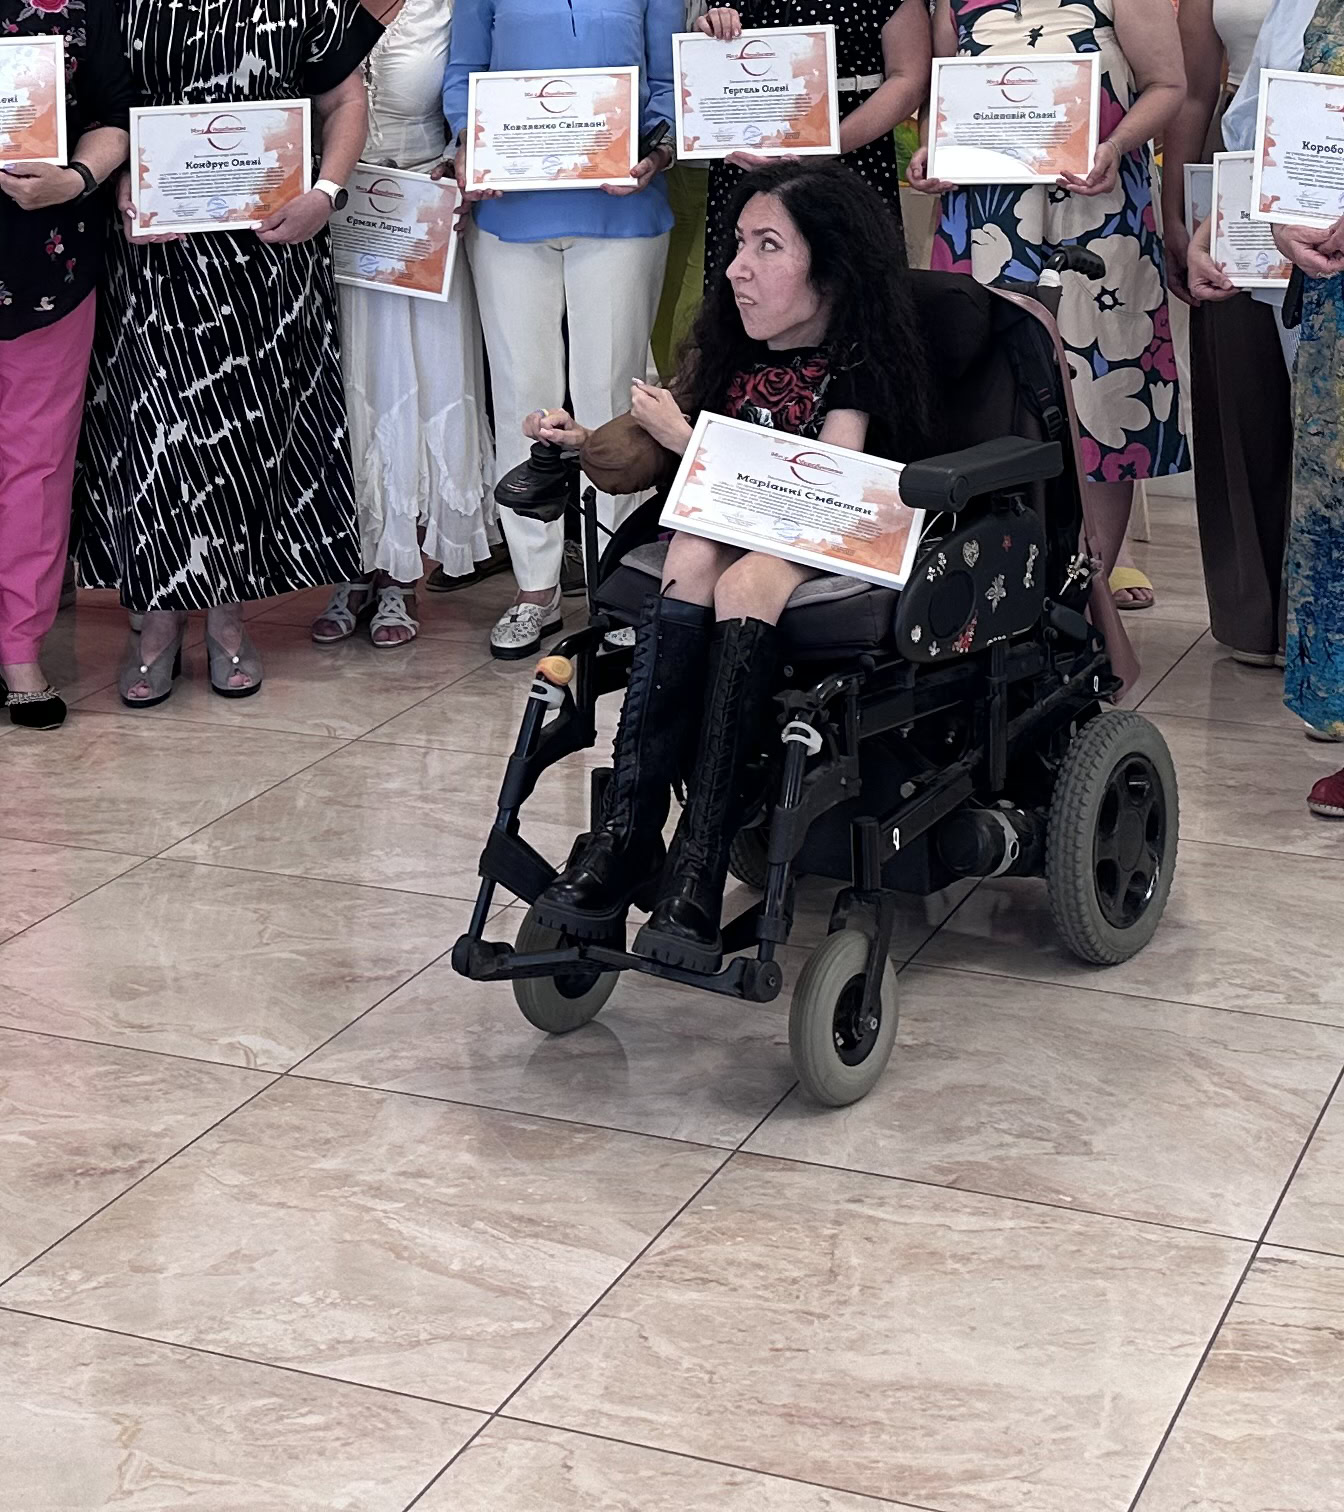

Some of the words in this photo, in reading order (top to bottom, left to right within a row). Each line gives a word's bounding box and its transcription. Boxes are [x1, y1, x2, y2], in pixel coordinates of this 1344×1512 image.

[185, 161, 229, 169] Кондрус
[231, 157, 261, 167] Олені
[736, 472, 802, 497] Маріанні
[804, 491, 873, 516] Смбатян
